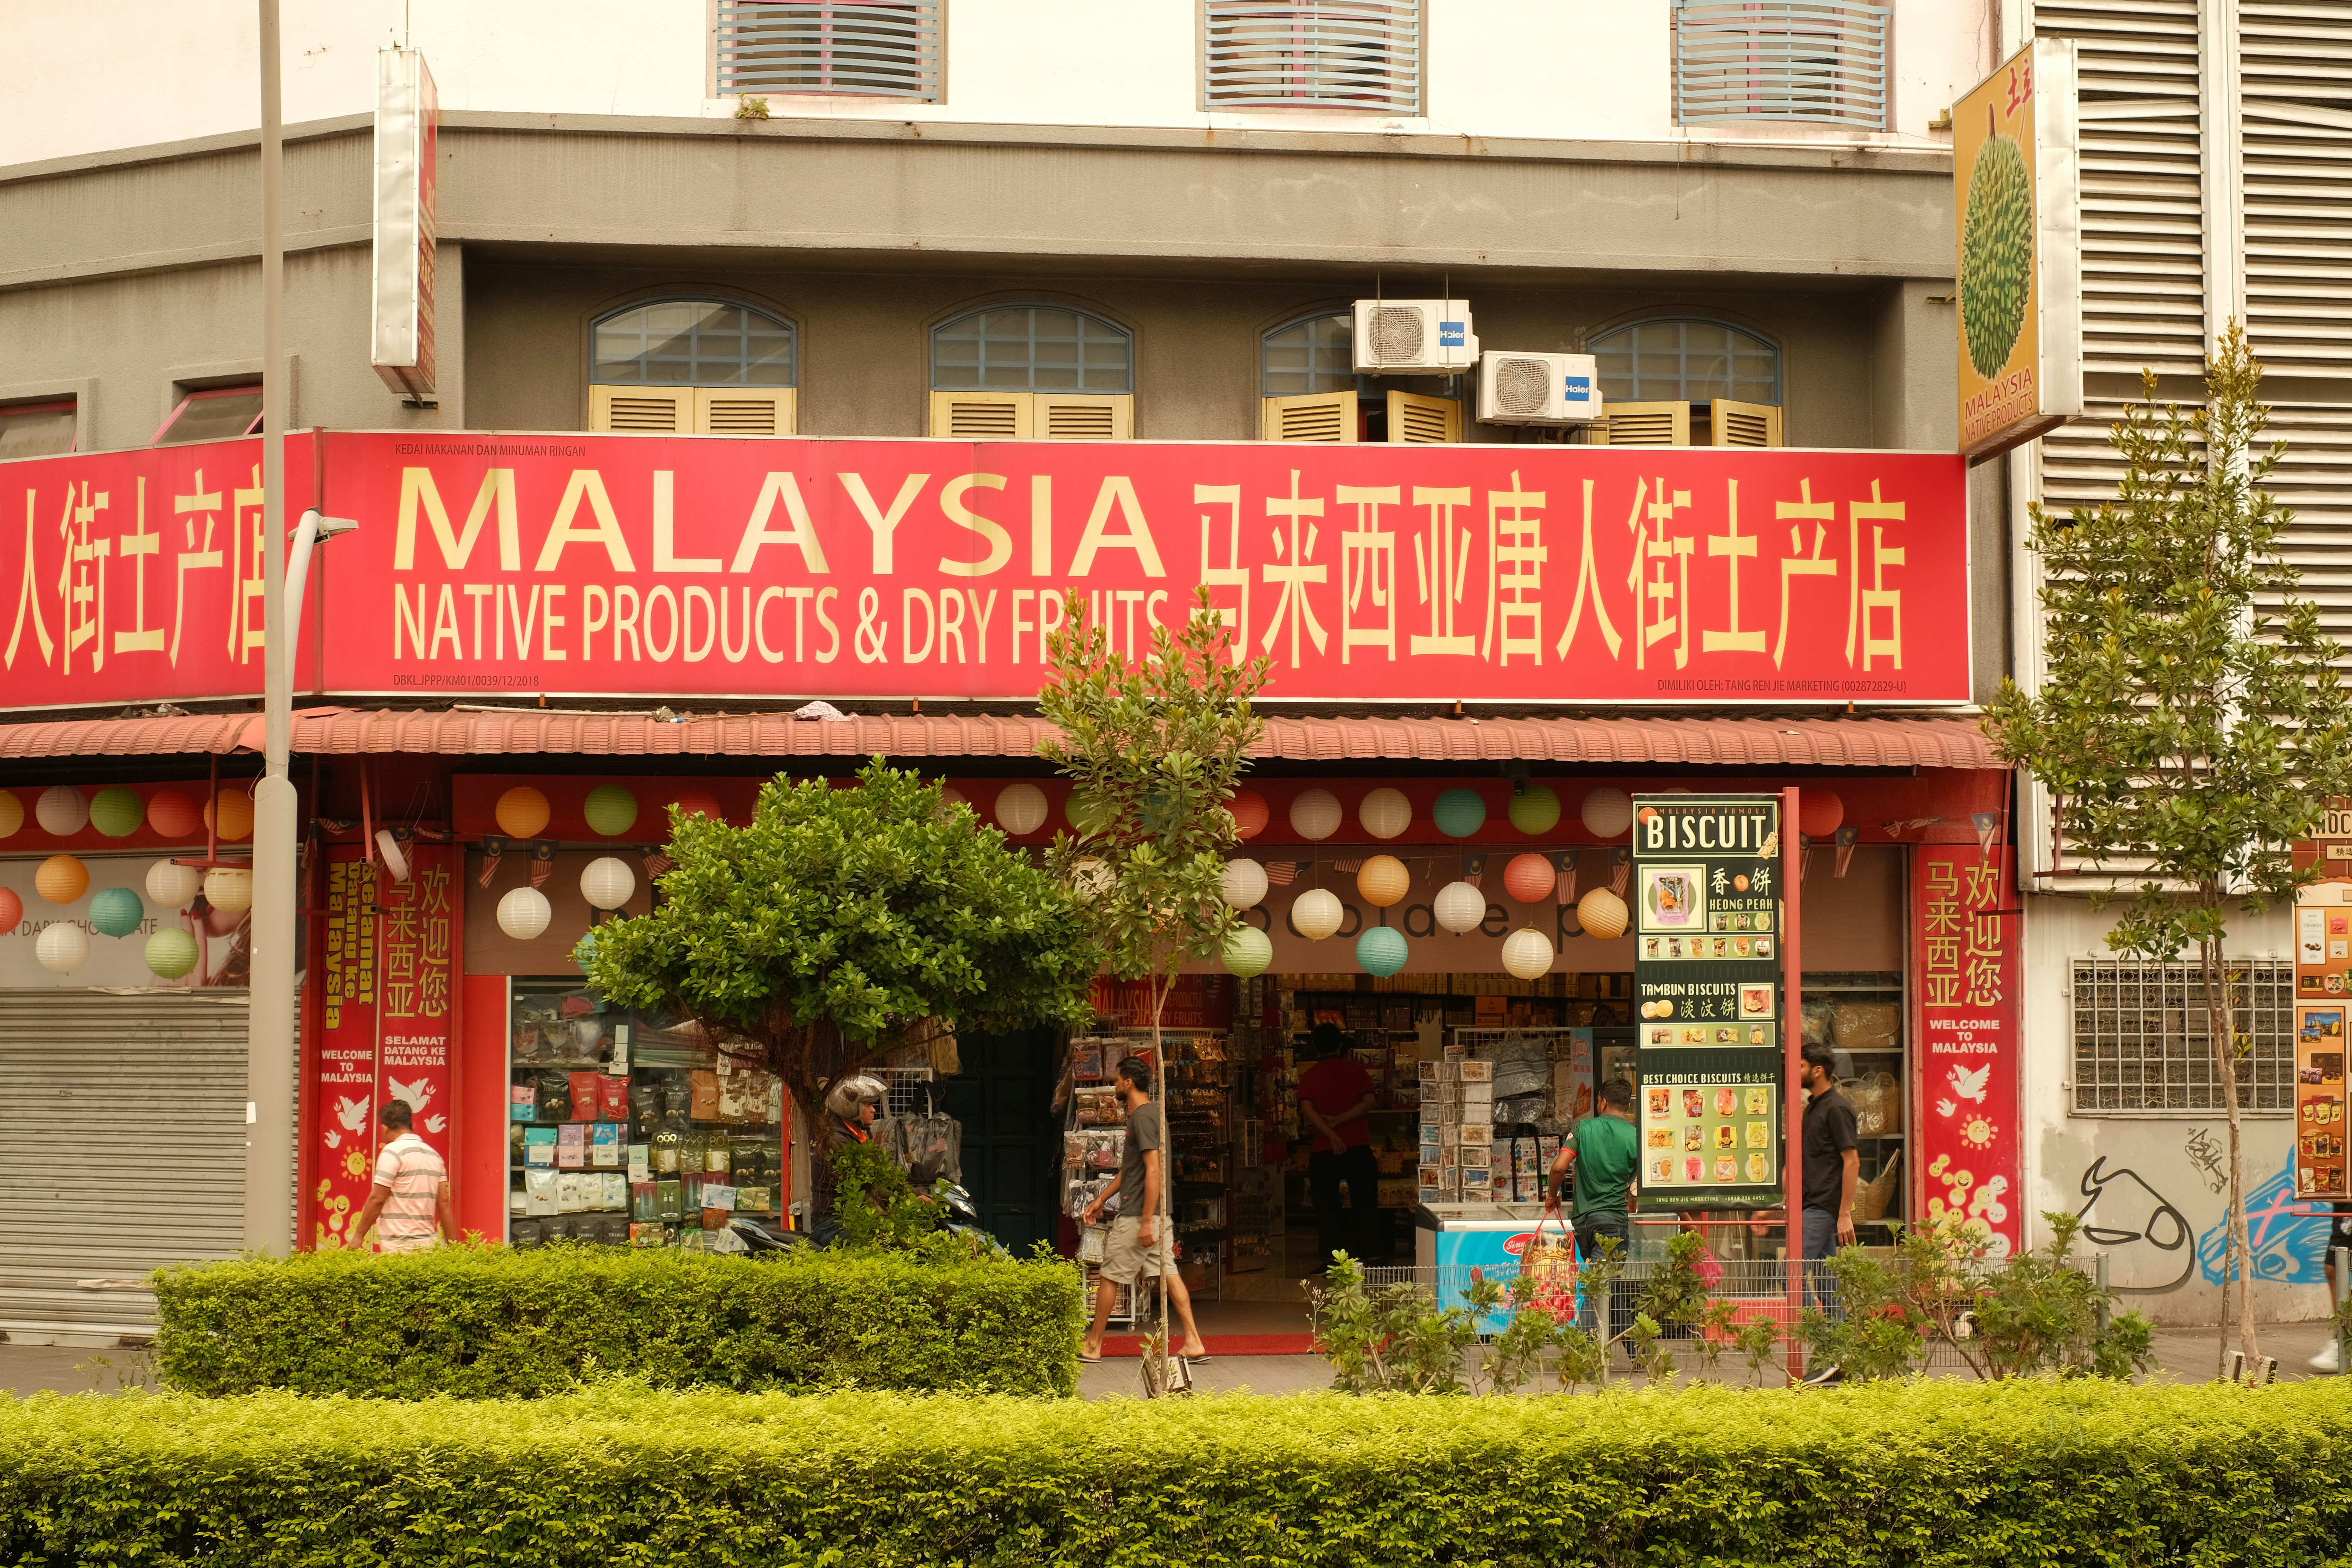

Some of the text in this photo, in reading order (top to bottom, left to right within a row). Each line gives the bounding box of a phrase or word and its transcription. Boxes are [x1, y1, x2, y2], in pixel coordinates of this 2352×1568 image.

[1566, 385, 1589, 394] Haier
[1965, 368, 2032, 420] MALAYSIA
[1965, 391, 2032, 444] NATIVE PRODUCTS
[395, 443, 585, 456] KEDAI MAKANAN DAN MINUMAN RINGAN
[394, 467, 1167, 577] MALAYSIA
[4, 463, 264, 675] 人街土产店
[1190, 469, 1905, 671] 马来西亚唐人街土产店
[394, 583, 566, 661] NATIVE
[583, 584, 839, 663] PRODUCTS
[854, 586, 888, 664] &
[903, 588, 998, 664] DRY
[1658, 679, 1906, 693] DIMILIKI OLEH: TANG REN JIE MARKETING (002872829-U)
[1647, 815, 1766, 848] BISCUIT
[1709, 899, 1773, 910] HEONG PEAH
[23, 920, 60, 936] DAR
[67, 919, 158, 936] HOATE
[1924, 861, 1962, 1007] 马来西亚
[1965, 860, 2003, 1007] 欢迎您
[325, 862, 346, 1030] Malaysia
[384, 866, 417, 1018] 马来西亚
[417, 864, 451, 1017] 欢迎您
[345, 966, 358, 998] ke
[1641, 983, 1736, 996] TAMBUN BISCUITS
[1173, 991, 1197, 1008] PRODUCTS
[1680, 998, 1736, 1019] 淡汶饼
[1174, 1011, 1203, 1025] FRUITS
[1930, 1020, 2000, 1030] WELCOME
[385, 1036, 446, 1045] SELAMAT
[1957, 1032, 1973, 1041] TO
[322, 1050, 372, 1060] WELCOME
[384, 1047, 446, 1055] DATANG KE
[1932, 1043, 1998, 1054] MALAYSIA
[340, 1063, 353, 1072] TO
[384, 1056, 446, 1066] MALAYSIA
[321, 1073, 373, 1083] MALAYSIA
[1643, 1073, 1741, 1084] BEST CHOICE BISCUITS
[709, 1135, 725, 1147] 80
